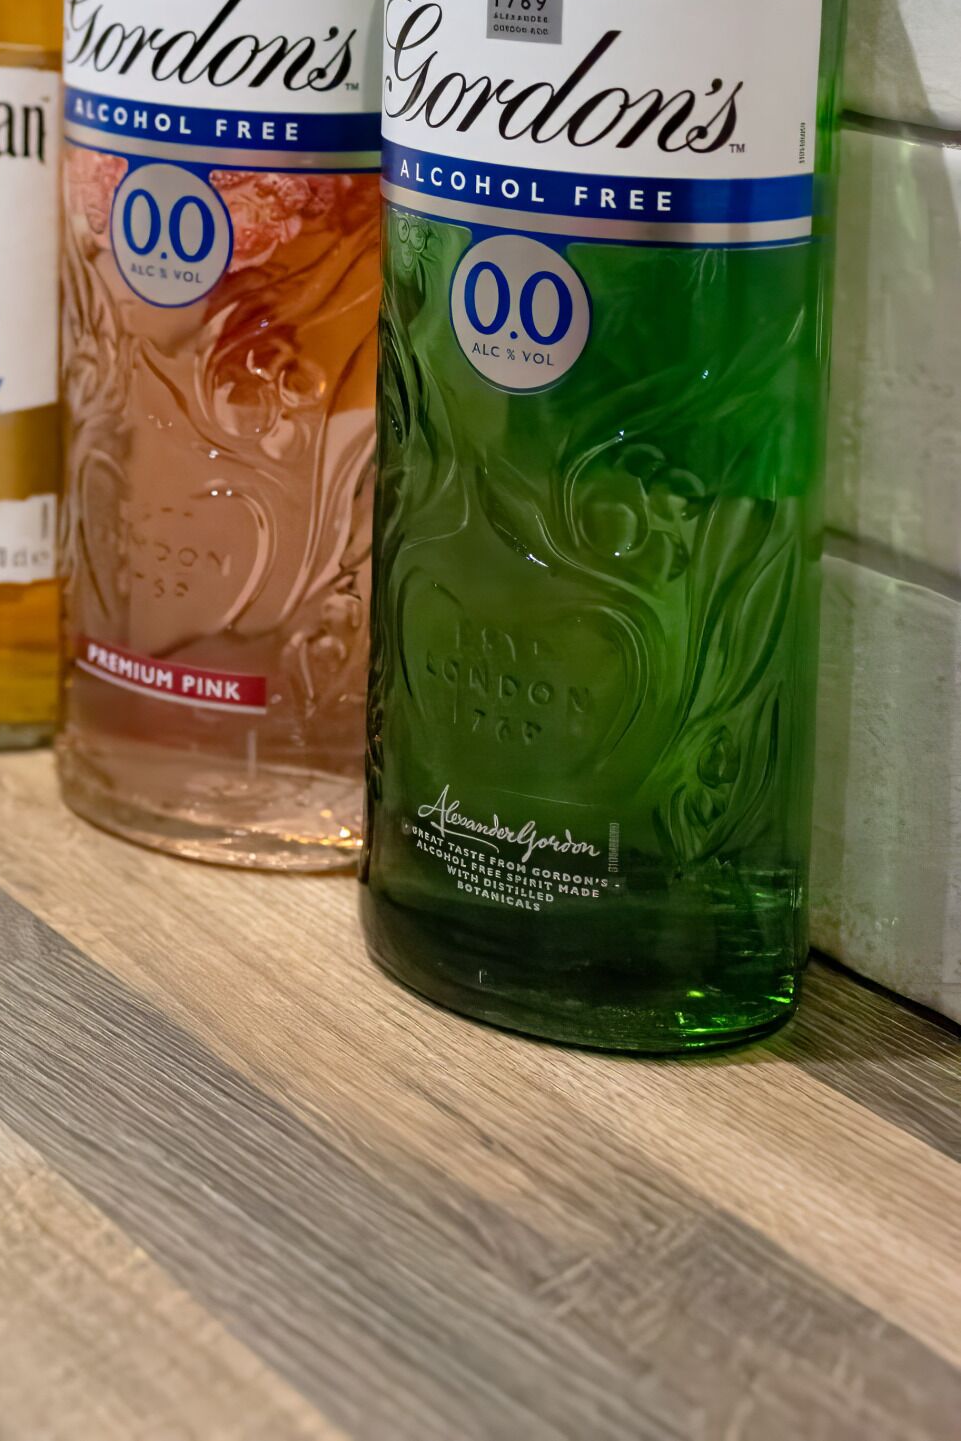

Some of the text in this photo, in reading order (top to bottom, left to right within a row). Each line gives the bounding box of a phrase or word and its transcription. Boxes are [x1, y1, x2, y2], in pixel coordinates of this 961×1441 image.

[75, 97, 299, 141] ALCOHOL FREE
[400, 159, 672, 211] ALCOHOL FREE
[123, 188, 215, 263] 0.0
[130, 263, 155, 277] ALC
[173, 269, 202, 283] VOL
[464, 261, 573, 345] 0.0
[472, 342, 555, 366] ALC % VOL
[88, 643, 241, 701] PREMIUM PINK
[411, 824, 608, 888] GREAT TASTE FROM GORDON'S
[515, 820, 600, 863] Gordon
[416, 839, 600, 899] ALCOHOL FREE SPIRIT MADE
[446, 864, 554, 903] WITH DISTILLED
[456, 879, 540, 912] BOTANICALS
